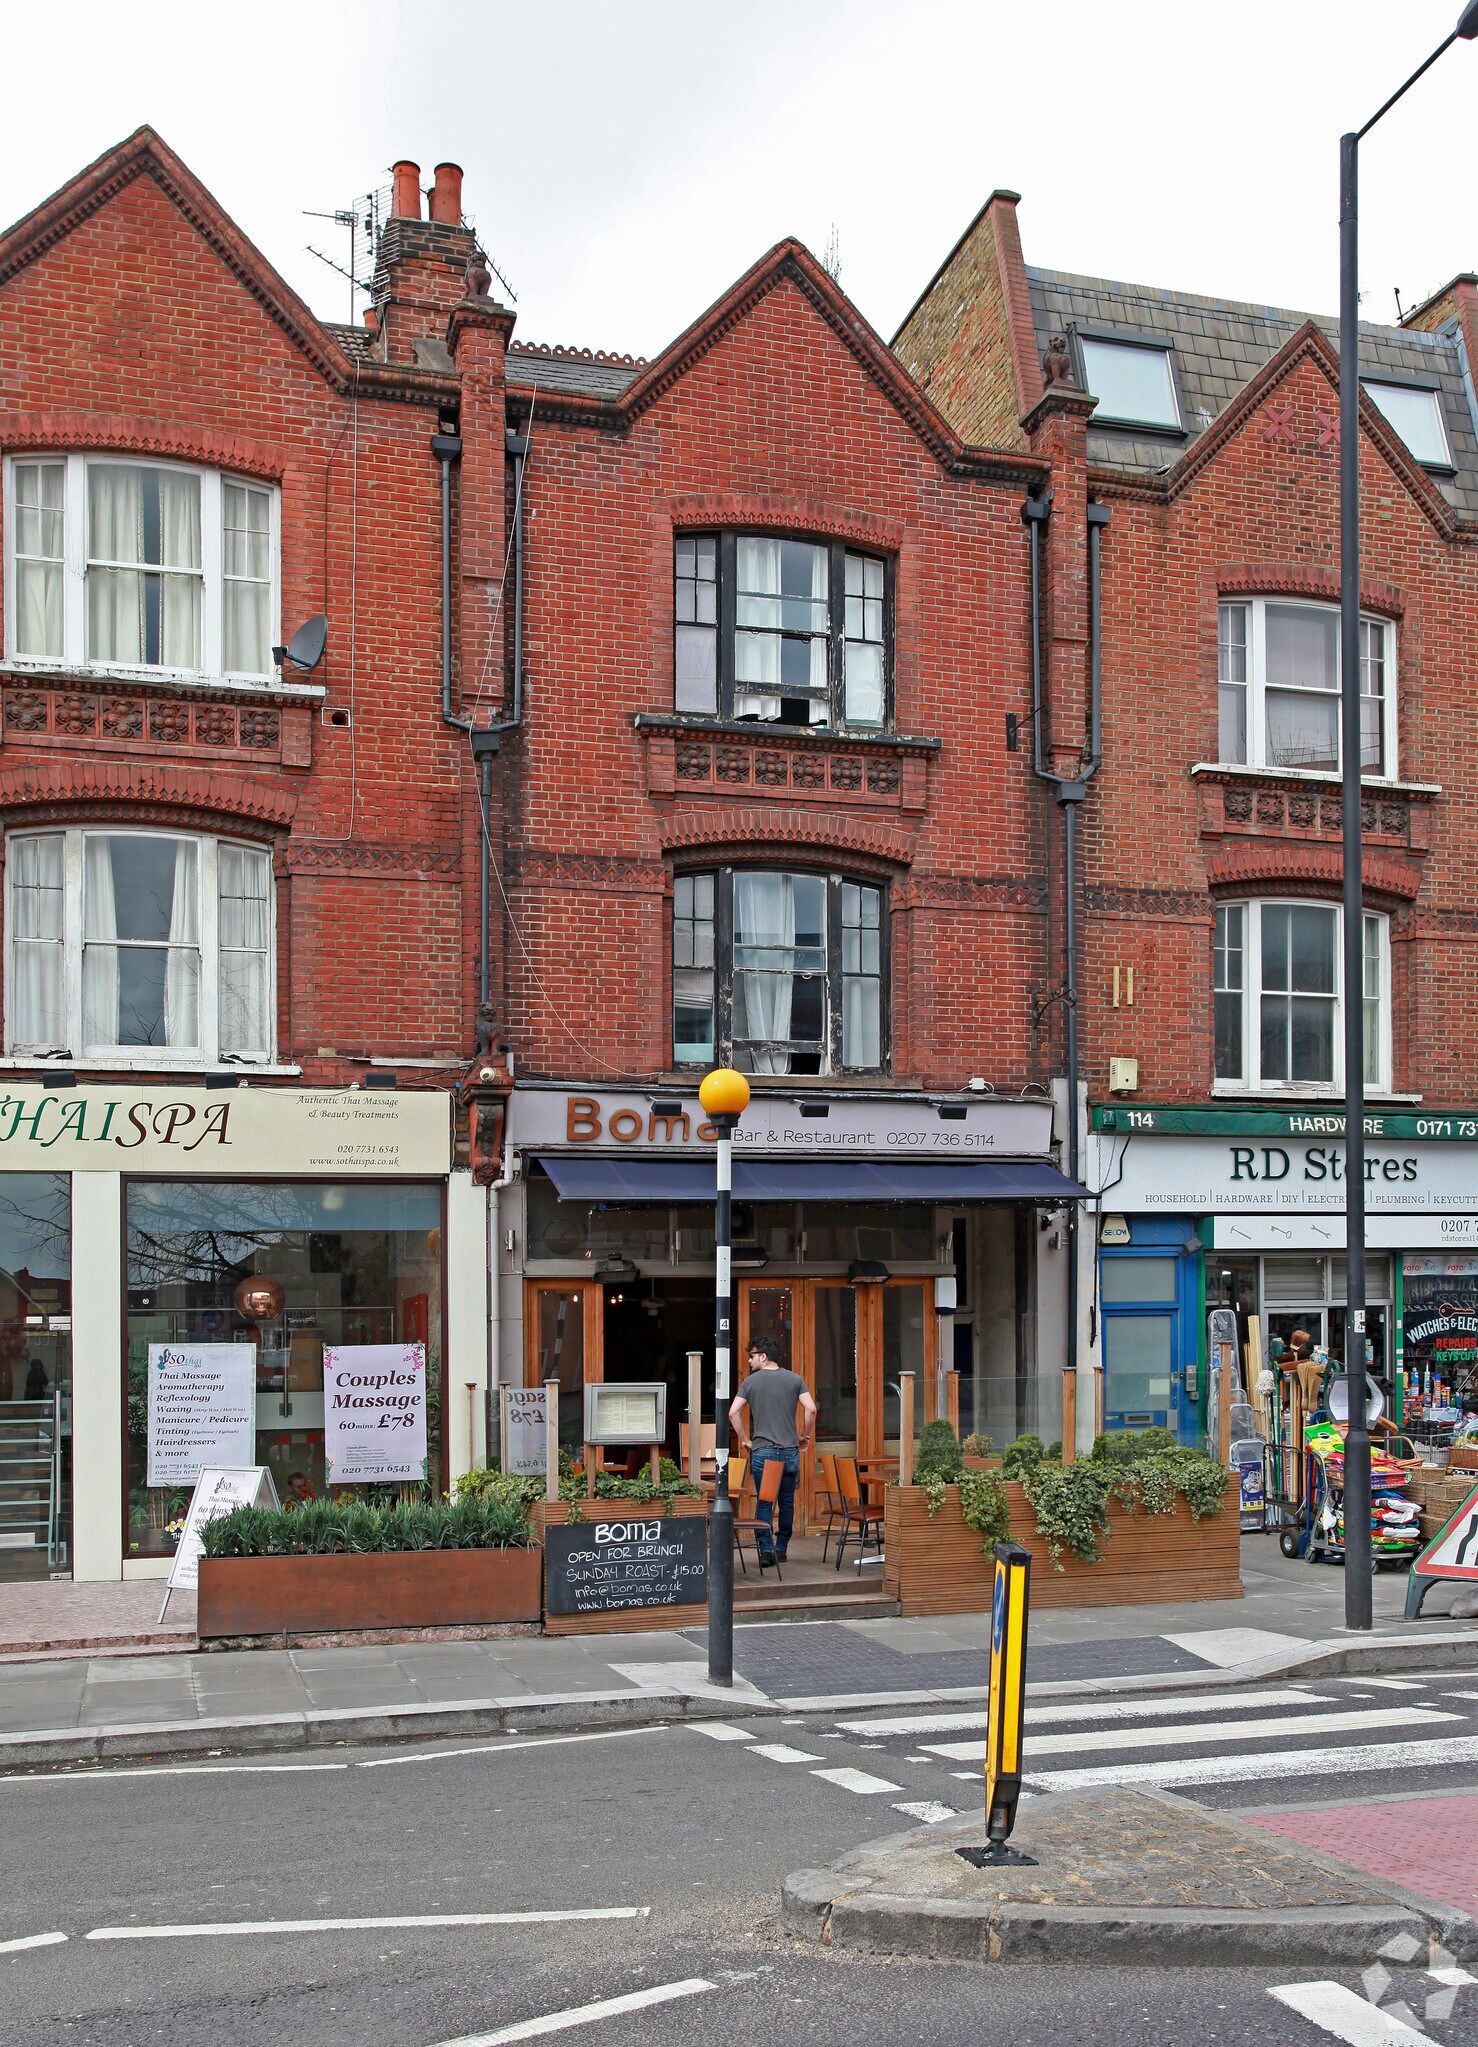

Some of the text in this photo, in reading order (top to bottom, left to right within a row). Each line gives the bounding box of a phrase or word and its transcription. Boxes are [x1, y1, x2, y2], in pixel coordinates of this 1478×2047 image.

[295, 1096, 399, 1108] Authentic Thai Massage
[308, 1109, 399, 1120] & Beauty Treatments
[1127, 1111, 1154, 1127] 114
[0, 1094, 233, 1151] HAISPA
[1289, 1116, 1478, 1137] HARDWRE 0171 73
[733, 1129, 762, 1143] Bar
[766, 1130, 778, 1143] &
[784, 1129, 876, 1144] Restaurant
[886, 1131, 927, 1145] 0207
[931, 1132, 960, 1146] 736
[963, 1133, 995, 1147] 5114
[337, 1145, 399, 1154] 020 7731 6543
[309, 1156, 402, 1168] www.sothaispa.co.uk
[1229, 1147, 1418, 1181] RD Stres
[1145, 1194, 1478, 1204] HOUSEHOLD HARDWARE DIY ELECTR PLUMBING KEYCUTT
[1441, 1219, 1470, 1232] 0207
[721, 1319, 729, 1329] 4
[1406, 1316, 1478, 1344] WATCHES & ELEC
[1435, 1337, 1477, 1349] REPAIRS
[1436, 1351, 1459, 1361] KEYS
[1460, 1352, 1475, 1361] CUT
[158, 1372, 222, 1381] Thai Massage
[336, 1370, 416, 1389] Couples
[156, 1383, 225, 1391] Aromatherapy
[156, 1394, 211, 1403] Reflexology
[331, 1394, 421, 1410] Massage
[156, 1405, 192, 1414] Waxing
[156, 1415, 250, 1425] Manicure / Pedicure
[377, 1412, 415, 1431] £78
[156, 1427, 190, 1436] Tinting
[155, 1438, 216, 1446] Hairdressers
[363, 1466, 385, 1475] 7731
[386, 1464, 411, 1474] 6543
[198, 1504, 209, 1513] 60
[567, 1543, 684, 1564] OPEN FOR BRUNCH
[566, 1564, 618, 1583] SUNDAY
[577, 1593, 677, 1611] www.bomas.co.uk
